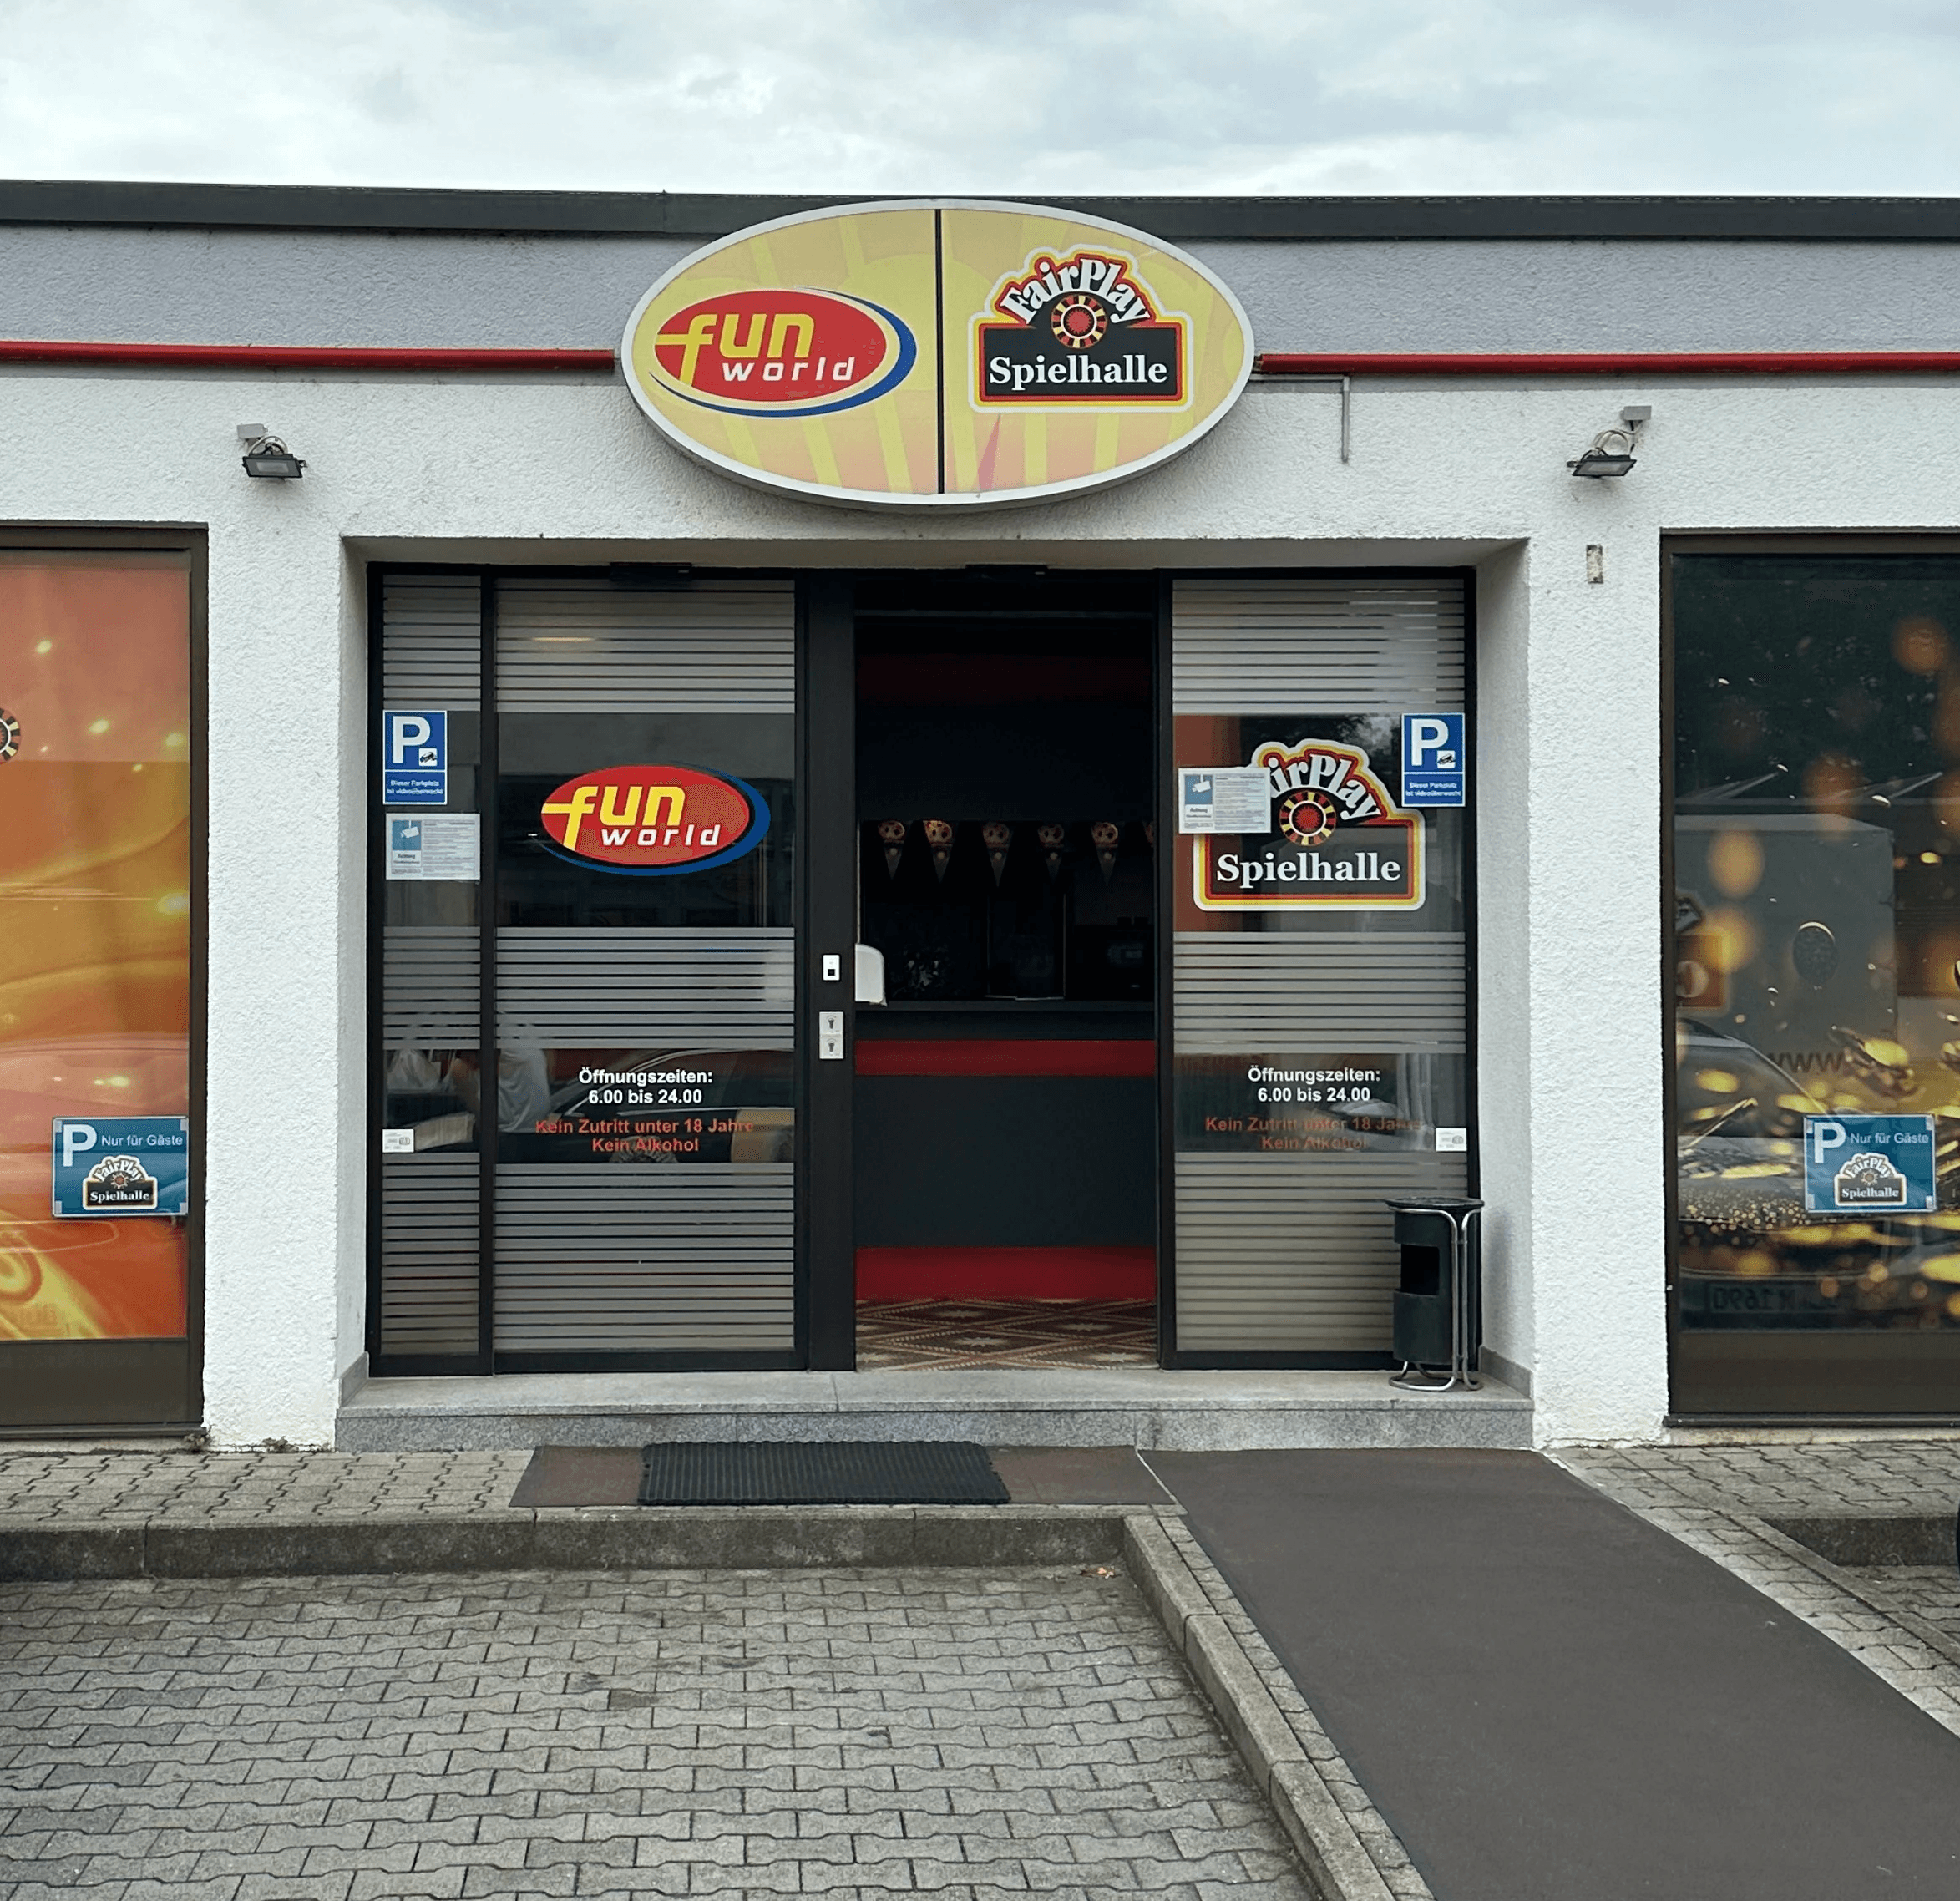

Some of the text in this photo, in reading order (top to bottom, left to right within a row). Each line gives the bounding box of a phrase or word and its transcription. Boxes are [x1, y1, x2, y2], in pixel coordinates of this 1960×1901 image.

[1000, 257, 1151, 325] FairPlay
[656, 312, 815, 388] fun
[721, 355, 854, 383] world
[988, 353, 1168, 390] Spielhalle
[392, 716, 431, 763] P
[1411, 718, 1449, 767] P
[1269, 753, 1382, 821] irPlay
[541, 785, 686, 851] fun
[601, 824, 721, 846] world
[1216, 852, 1401, 890] Spielhalle
[579, 1067, 712, 1087] Öffnungszeiten:
[1248, 1065, 1380, 1085] Öffnungszeiten:
[589, 1089, 702, 1104] 6.00 bis 24.00
[1258, 1087, 1370, 1102] 6.00 bis 24.00
[535, 1118, 754, 1133] Kein Zutritt unter 18 Jahre
[1205, 1117, 1243, 1131] Kein
[1353, 1116, 1371, 1130] 18
[63, 1124, 183, 1167] P Nur für Gäste
[592, 1137, 699, 1152] Kein Alkohol
[1262, 1136, 1298, 1150] Kein
[1814, 1122, 1929, 1163] P Nur für Gäste
[90, 1190, 149, 1204] Spielhalle
[1841, 1187, 1899, 1199] Spielhalle
